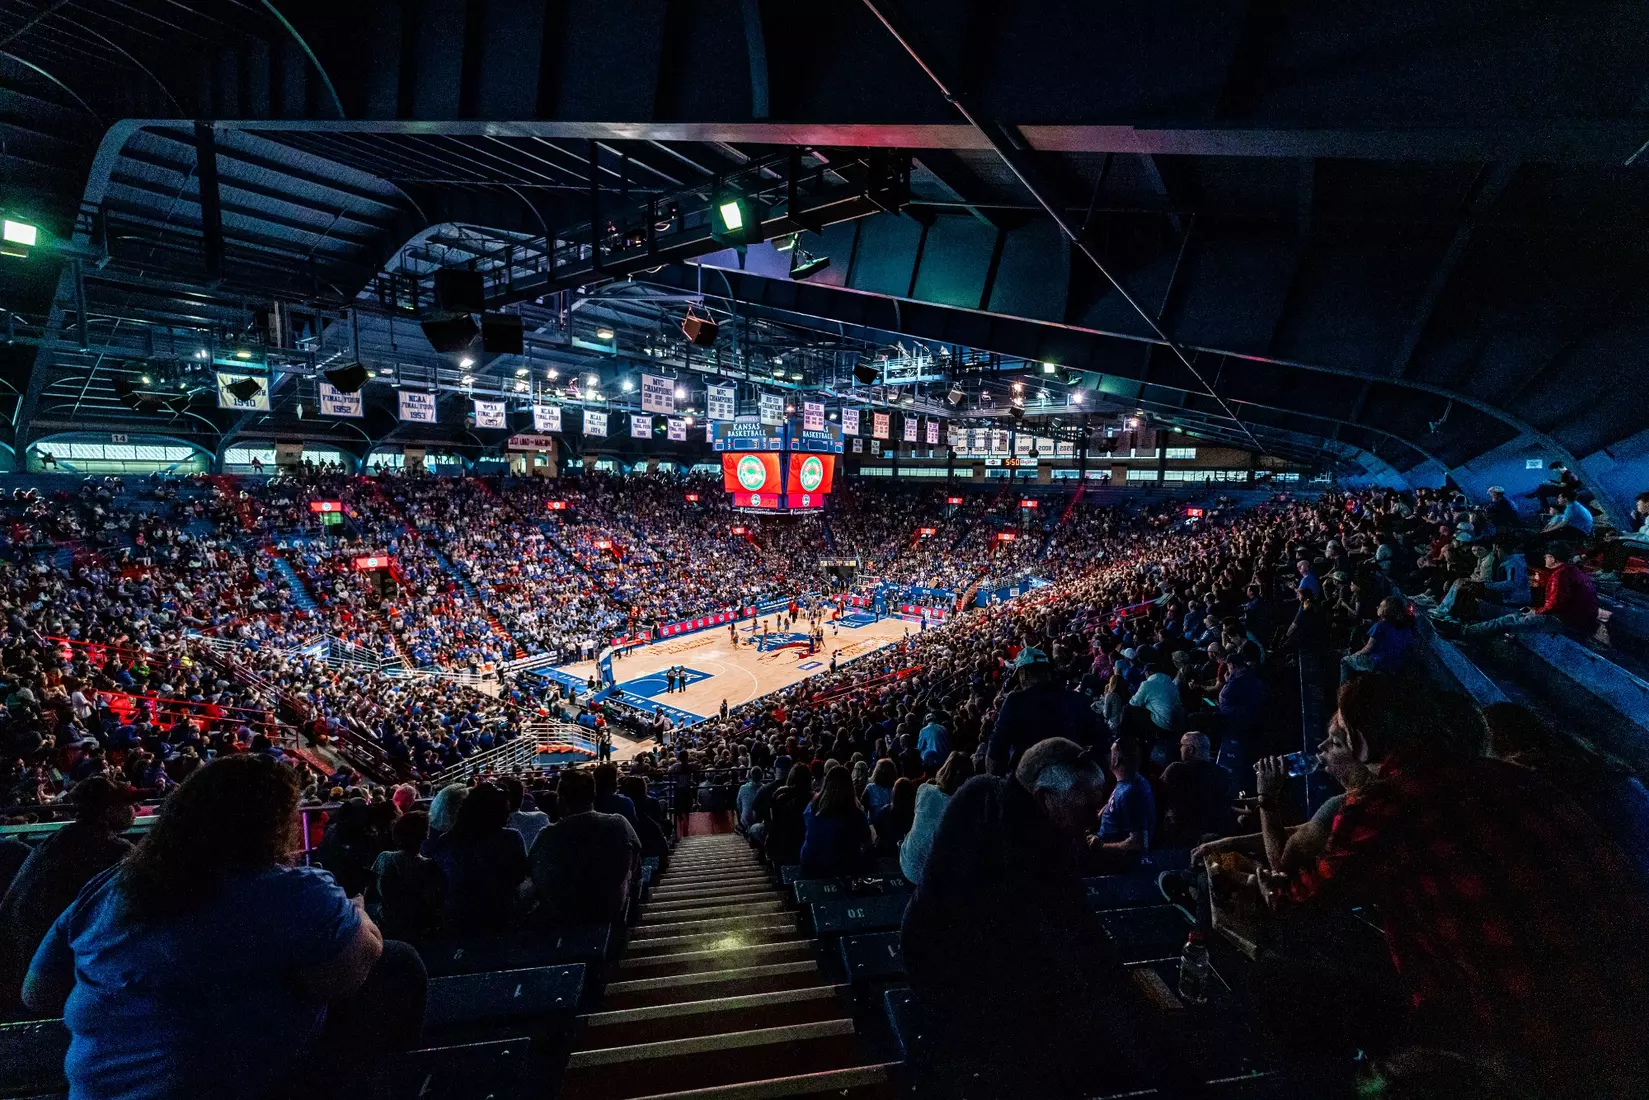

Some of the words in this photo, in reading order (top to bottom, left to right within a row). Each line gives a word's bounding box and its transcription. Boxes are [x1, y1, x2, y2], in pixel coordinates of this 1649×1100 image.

[323, 394, 342, 402] FINAL
[408, 395, 426, 403] NCAA
[234, 398, 256, 407] 1940
[333, 405, 351, 413] 1952
[410, 411, 426, 419] 1953
[733, 422, 760, 431] KANSAS
[803, 431, 833, 440] BASKETBALL
